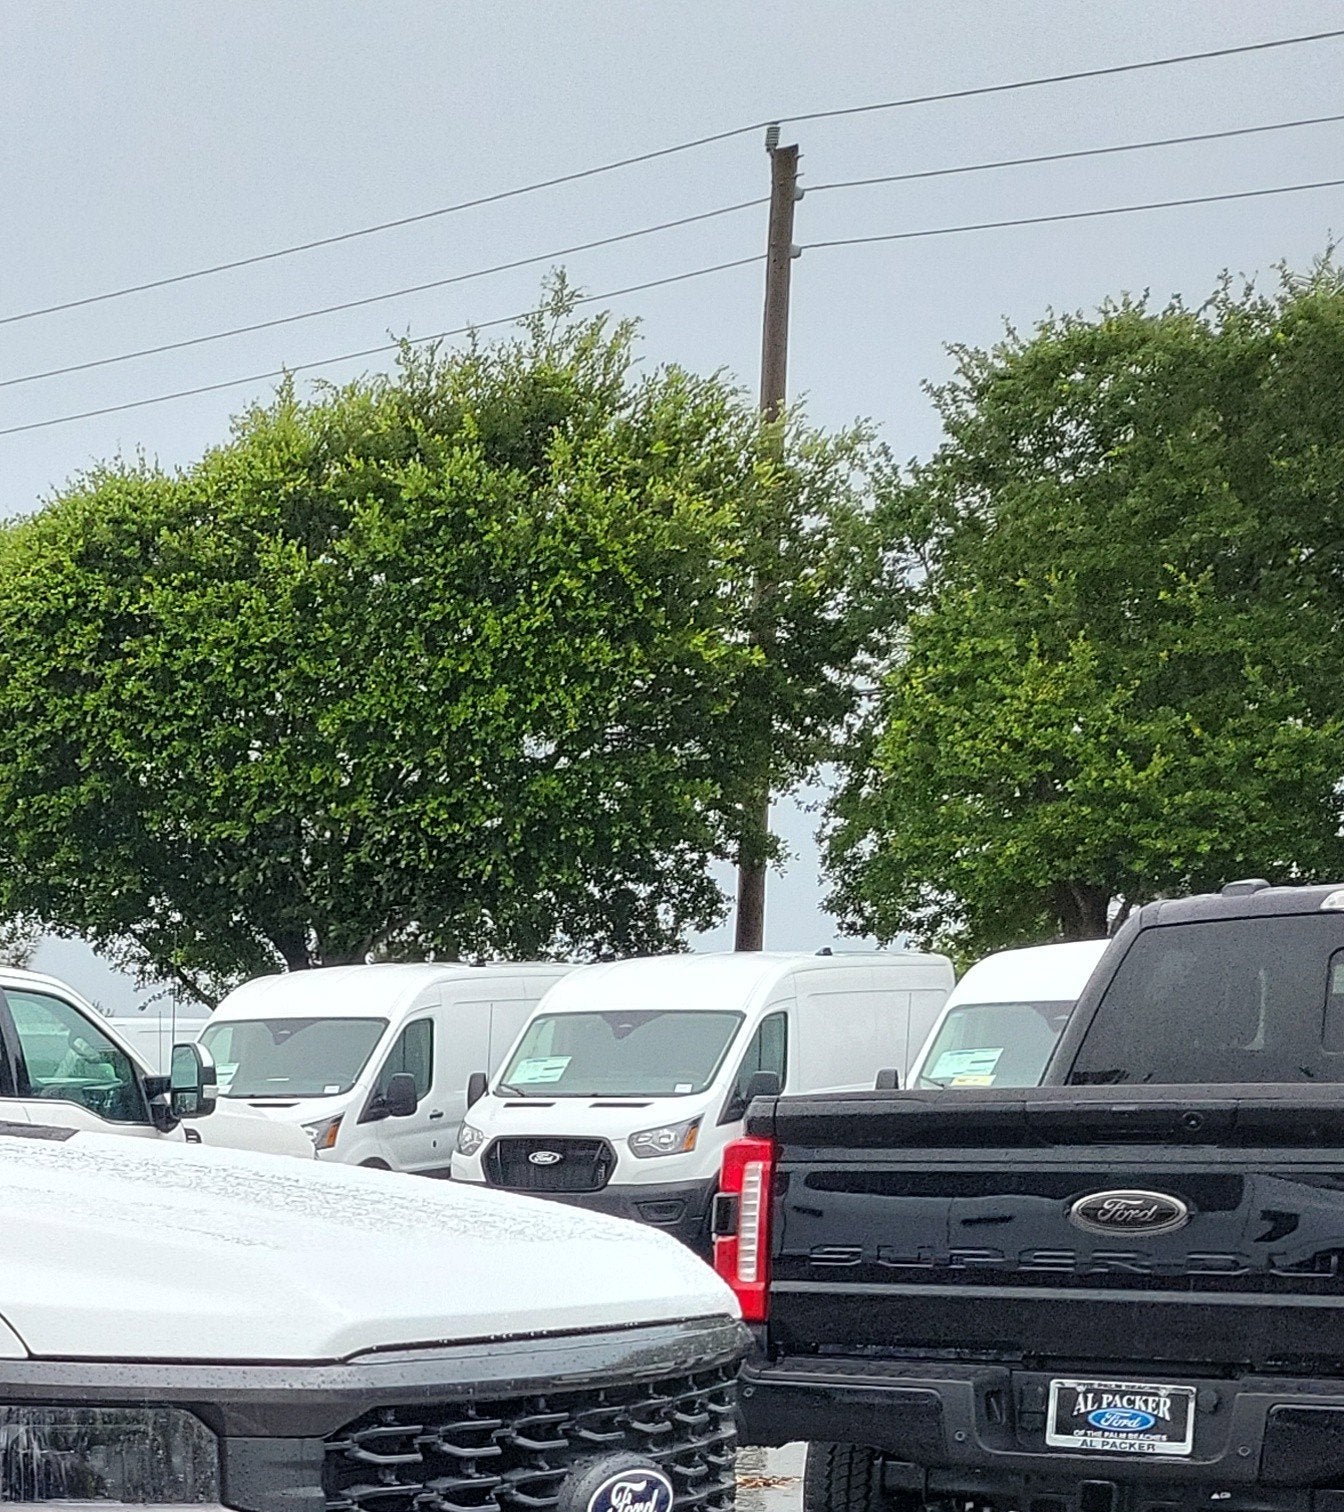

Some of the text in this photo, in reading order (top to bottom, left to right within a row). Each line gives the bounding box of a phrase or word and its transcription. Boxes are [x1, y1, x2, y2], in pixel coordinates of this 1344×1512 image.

[1097, 1199, 1158, 1222] Ford
[810, 1246, 1153, 1274] SUPER
[1072, 1393, 1171, 1421] AL PACKER
[1100, 1412, 1142, 1428] Ford
[1080, 1438, 1157, 1452] AL PACKER
[1104, 1431, 1127, 1440] PALM
[1127, 1432, 1168, 1442] BEACHES
